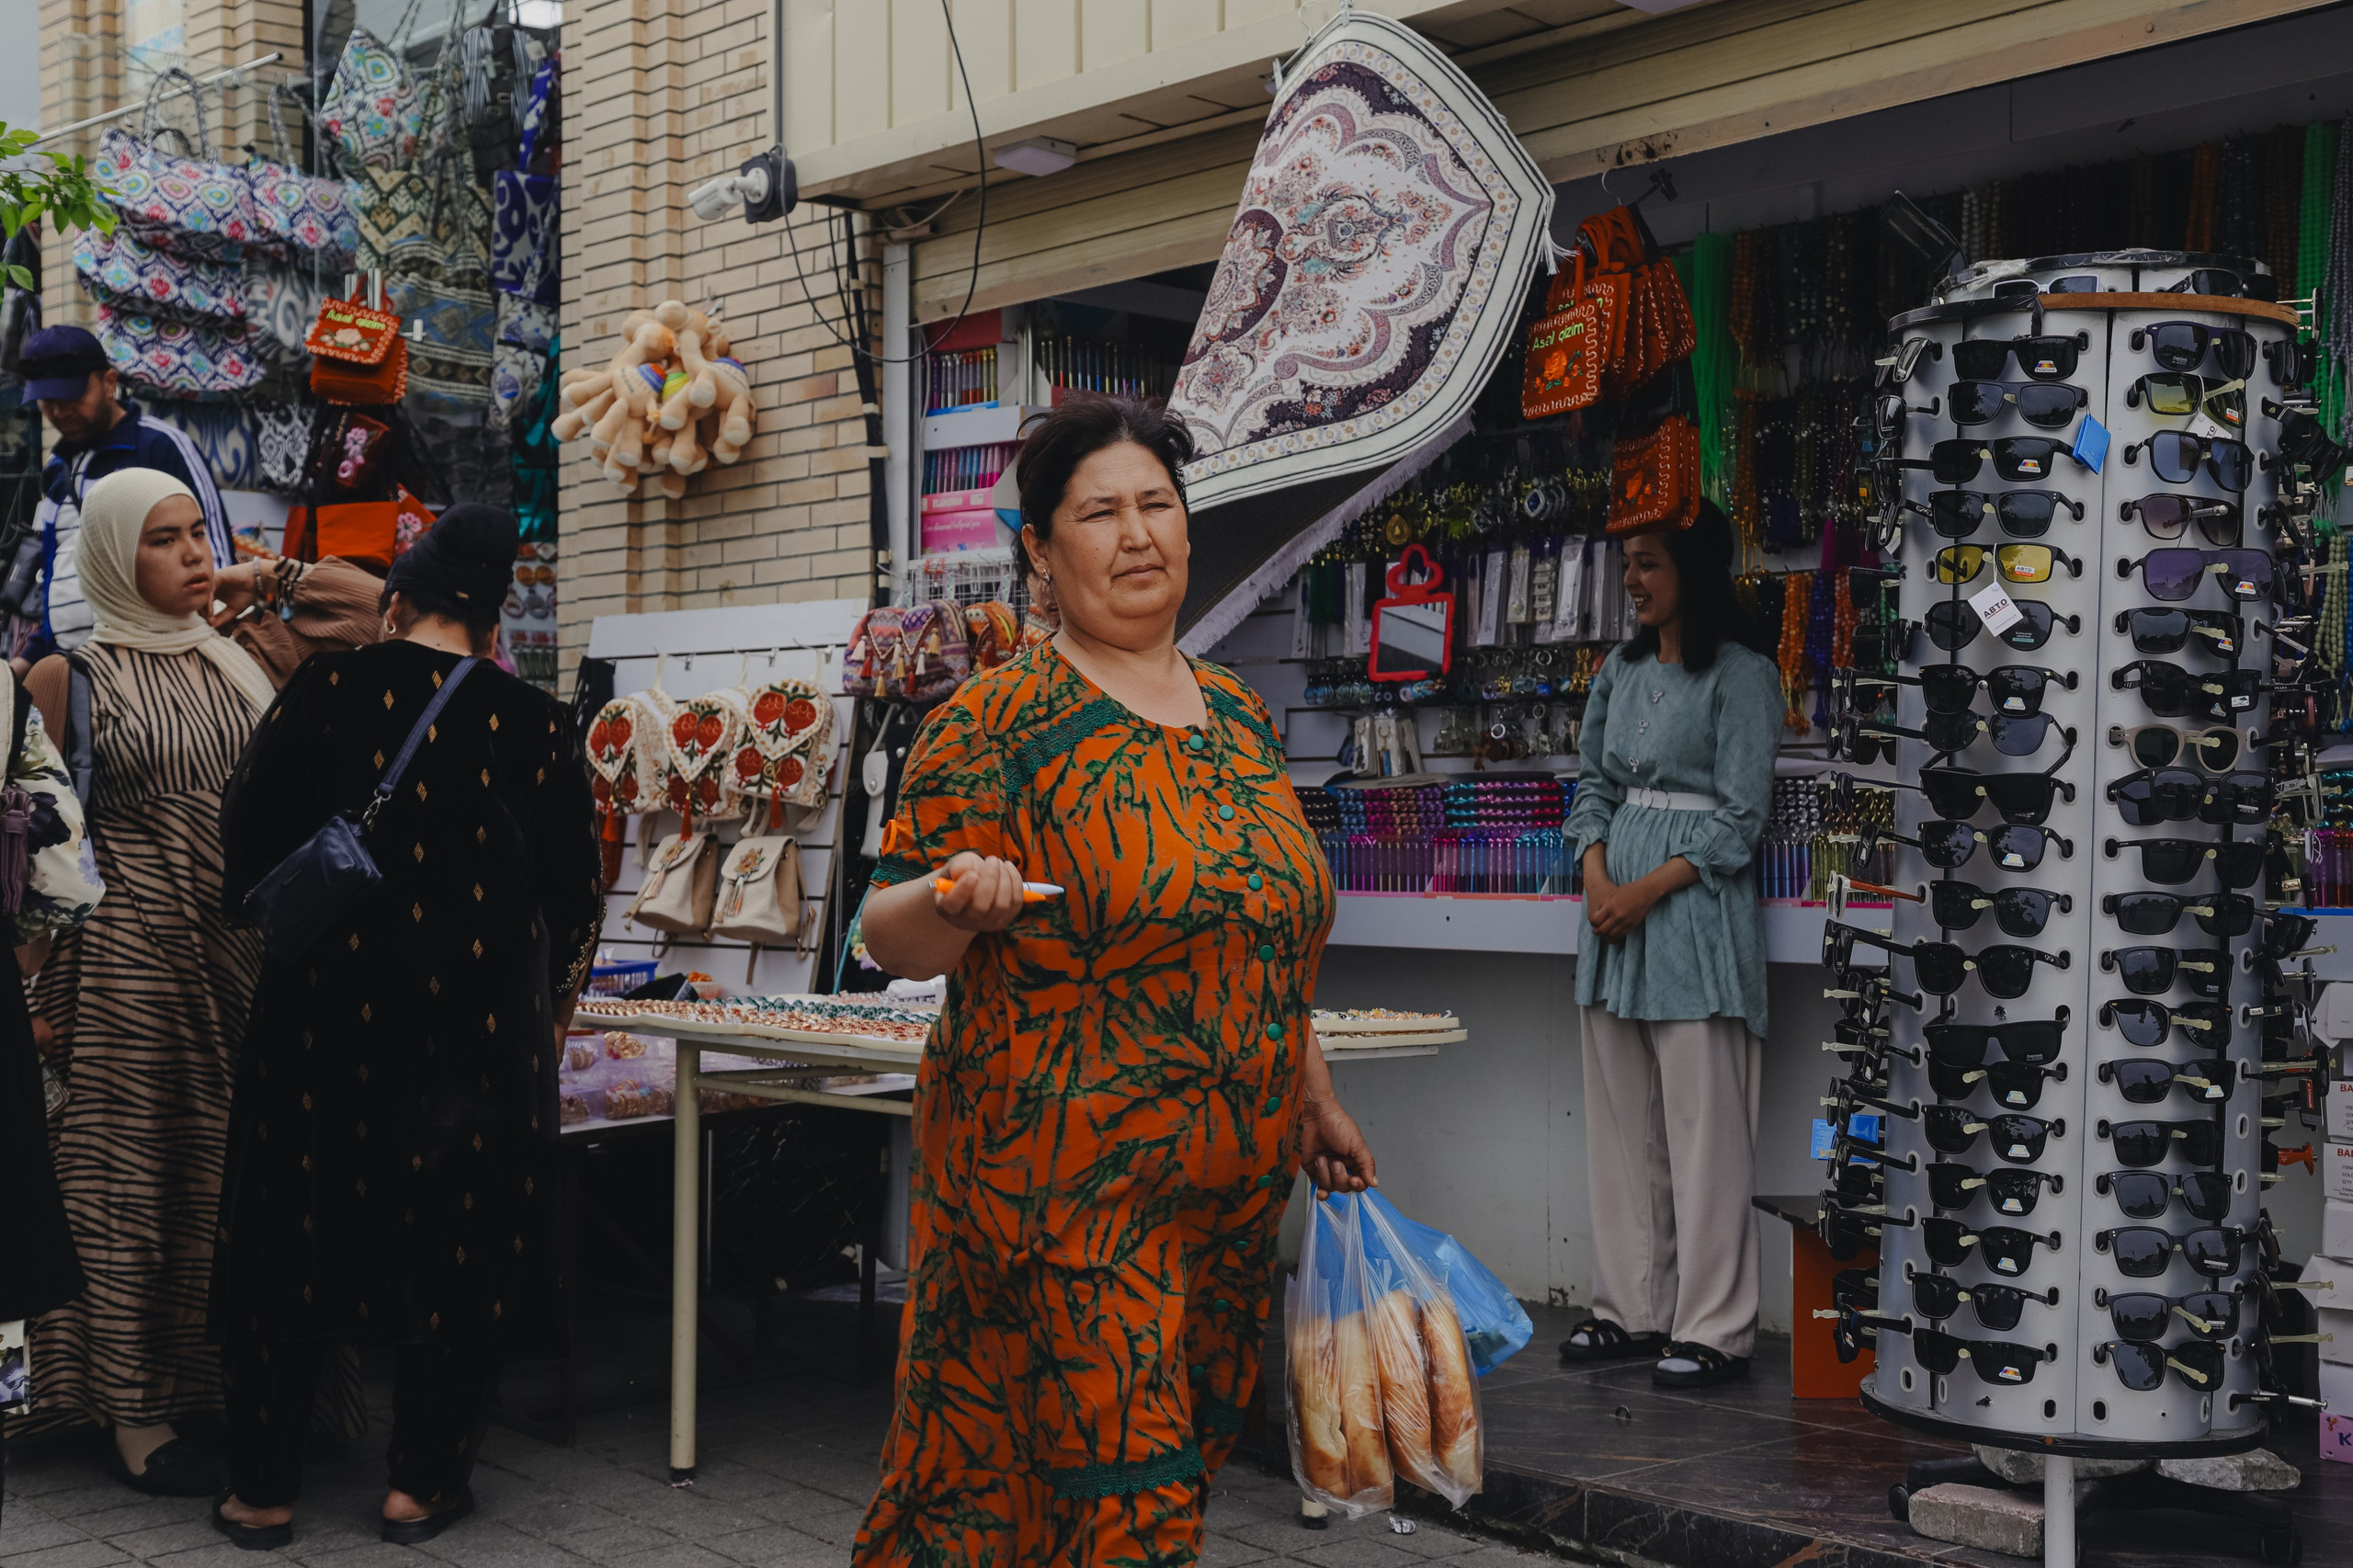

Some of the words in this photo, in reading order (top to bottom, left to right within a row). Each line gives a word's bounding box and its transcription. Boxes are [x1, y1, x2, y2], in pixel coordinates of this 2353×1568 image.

[1532, 330, 1555, 351] Asal
[1558, 322, 1584, 343] qizim
[2205, 425, 2216, 438] ТО
[1983, 598, 2007, 618] АВТО
